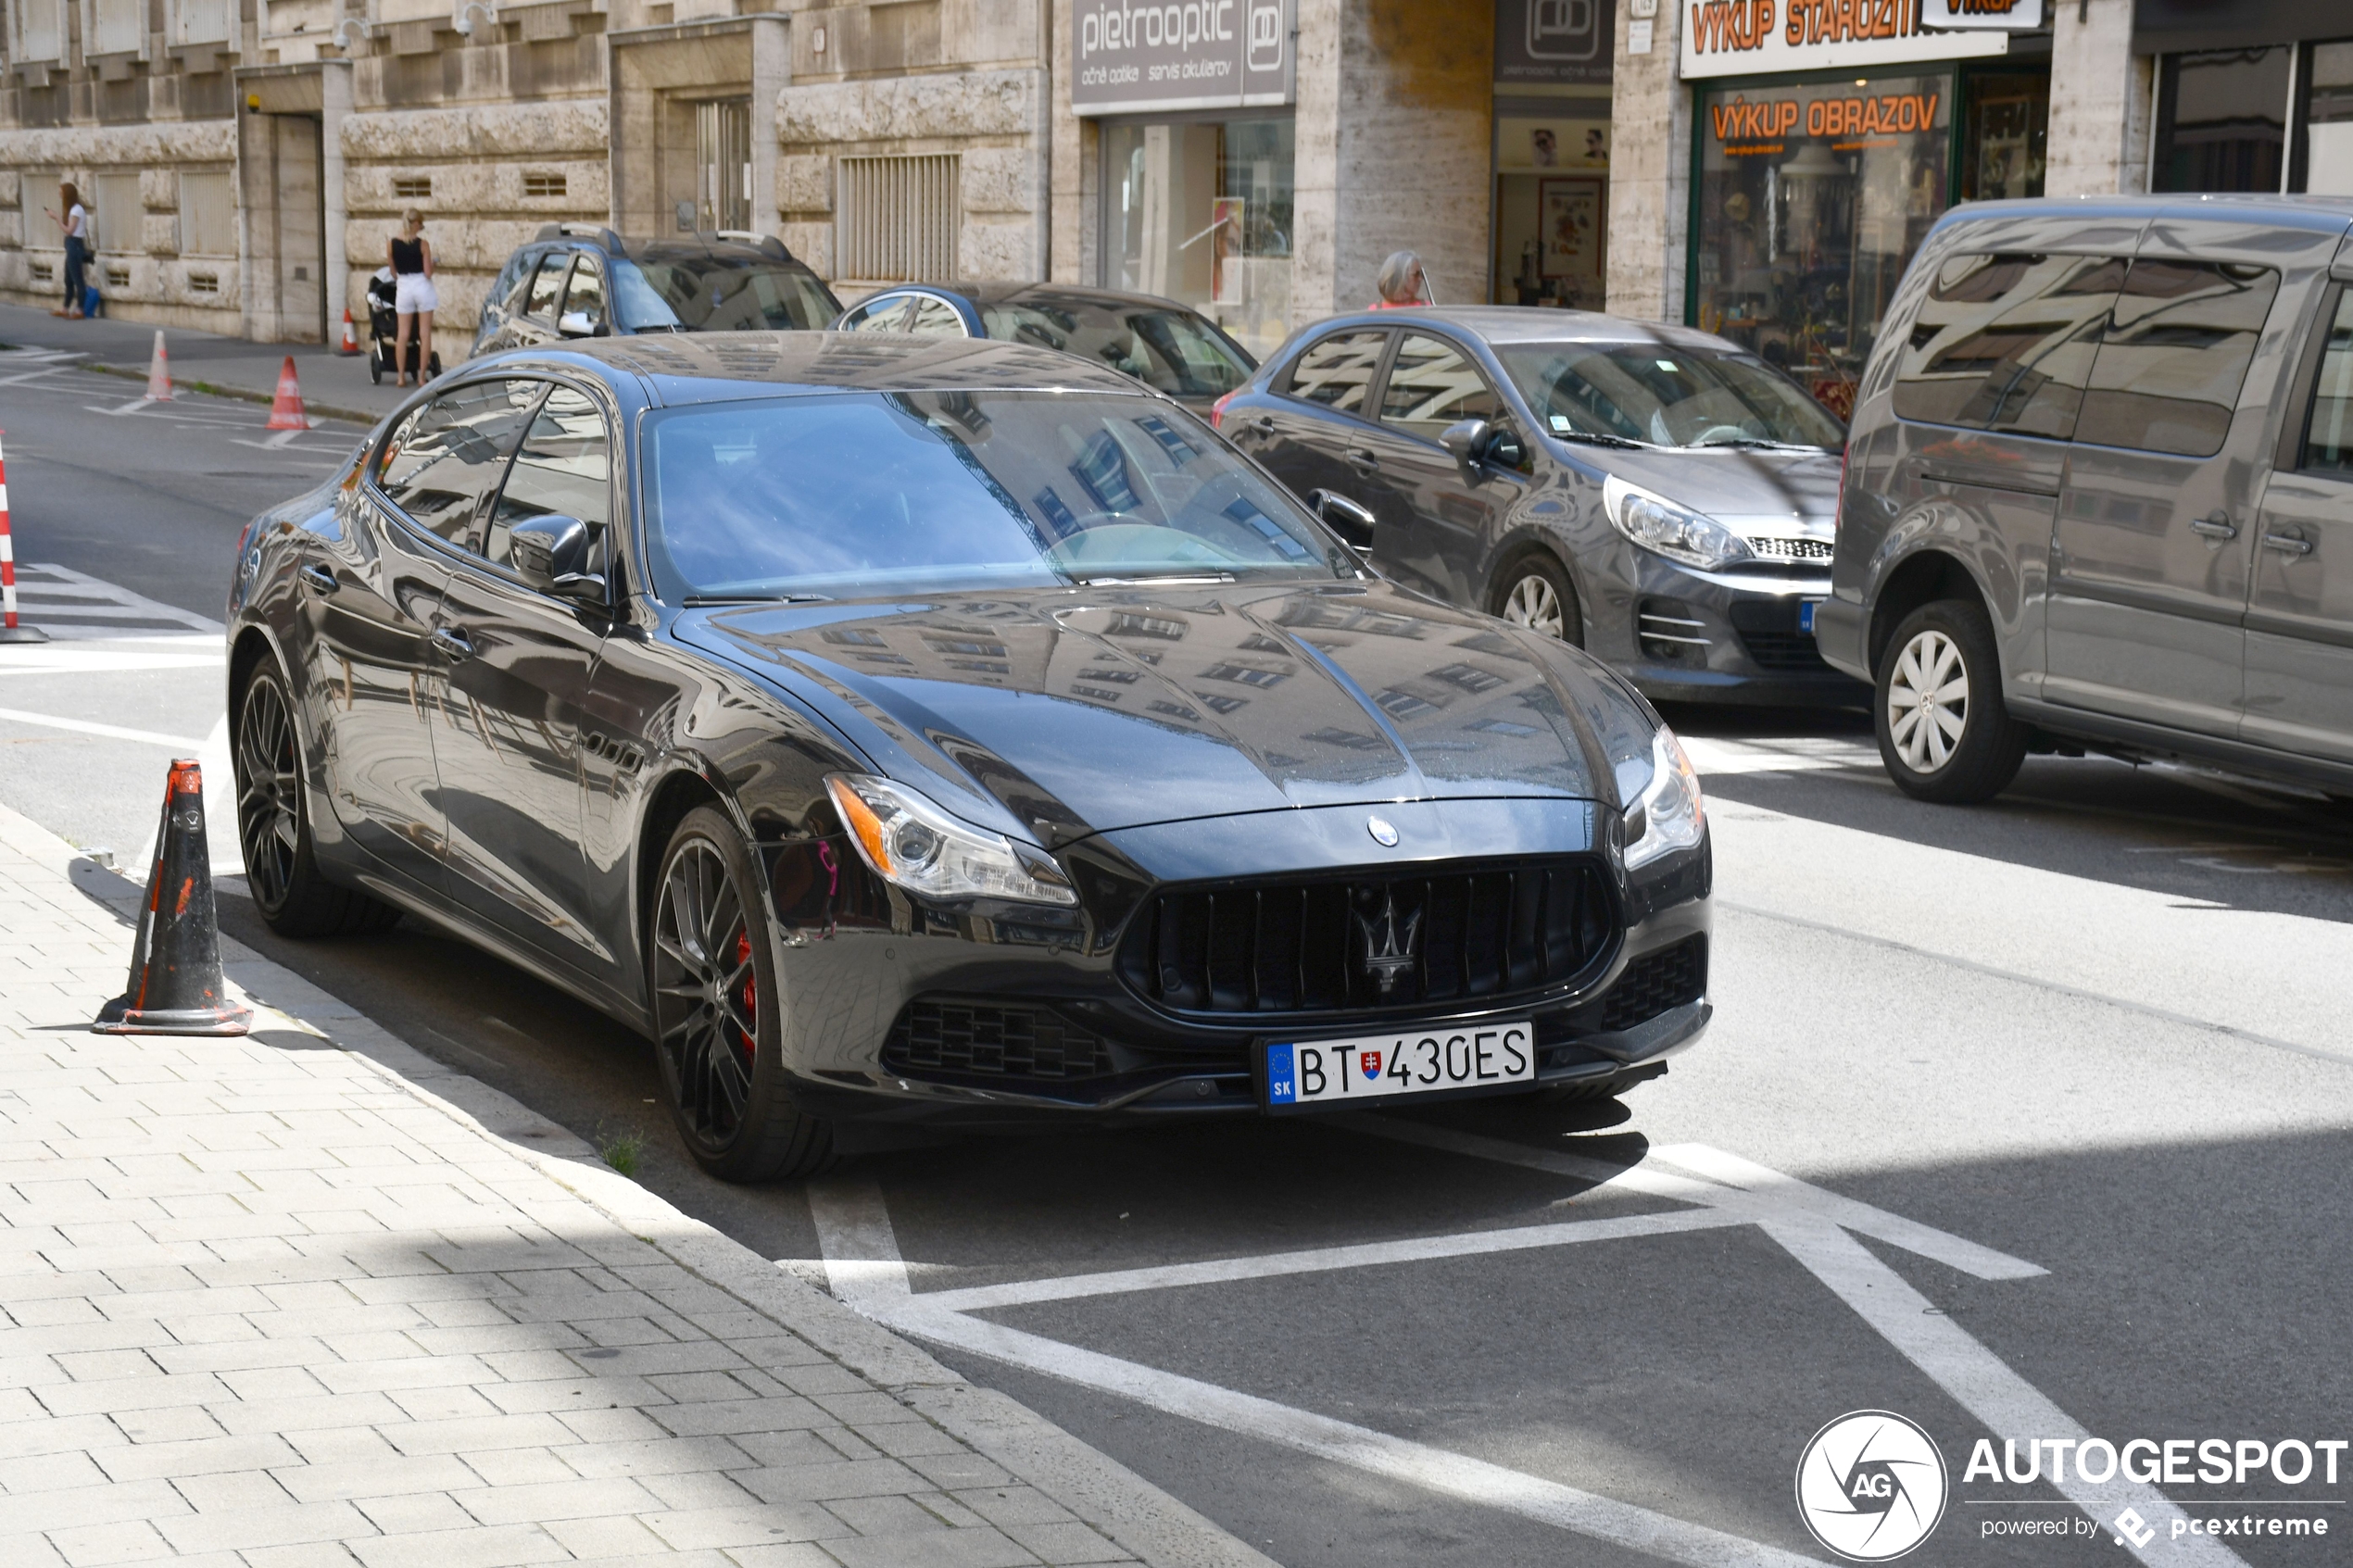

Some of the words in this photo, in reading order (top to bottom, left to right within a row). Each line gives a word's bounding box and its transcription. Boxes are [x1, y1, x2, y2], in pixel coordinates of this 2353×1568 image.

[1082, 0, 1233, 59] pietrooptic
[1081, 66, 1107, 85] očná
[1109, 65, 1139, 85] optika
[1148, 61, 1180, 82] servis
[1182, 59, 1232, 79] okuliarov
[1712, 94, 1799, 141] VÝKUP
[1806, 94, 1938, 137] OBRAZOV
[1274, 1081, 1291, 1097] SK
[1300, 1045, 1356, 1097] BT
[1387, 1029, 1528, 1087] 430ES
